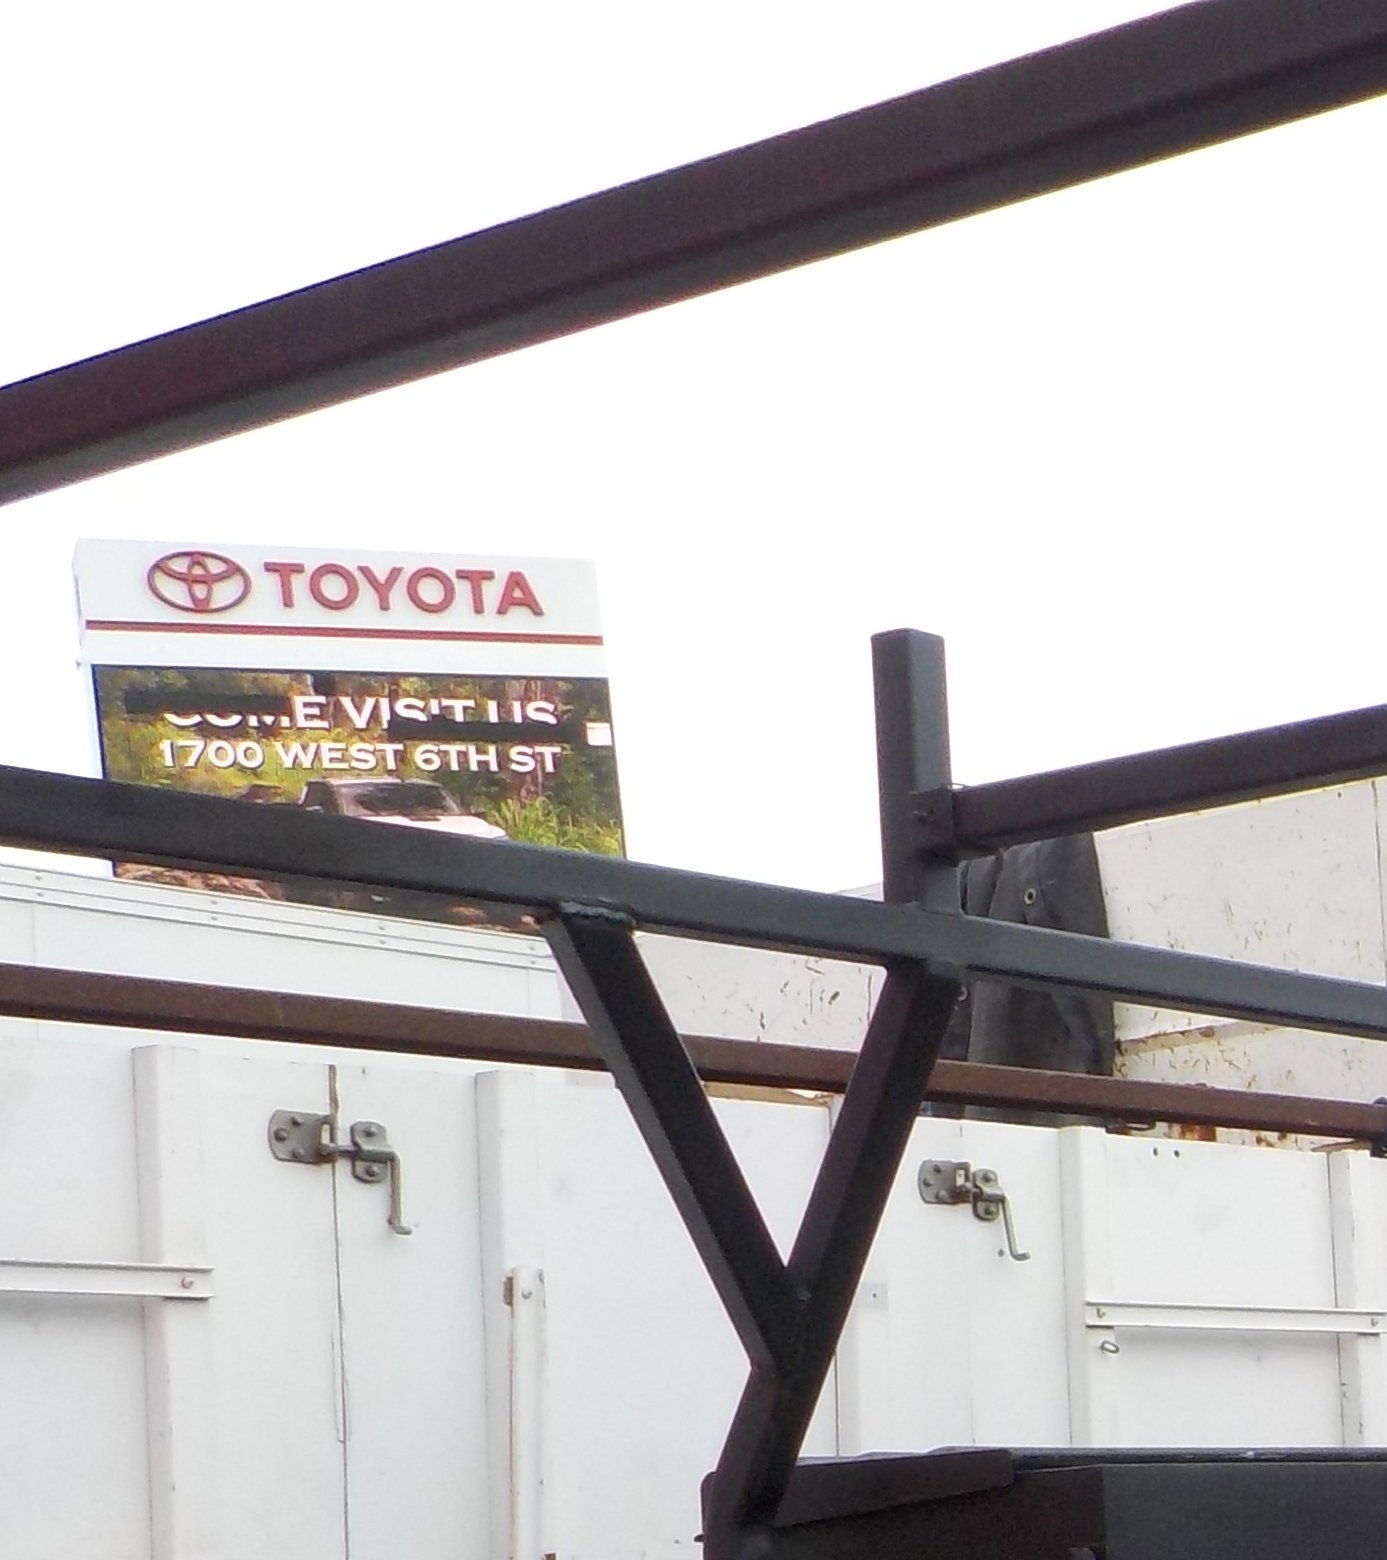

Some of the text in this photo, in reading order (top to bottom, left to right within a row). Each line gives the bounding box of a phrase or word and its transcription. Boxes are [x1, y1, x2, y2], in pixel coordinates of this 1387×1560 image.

[263, 562, 546, 616] TOYOTA
[160, 739, 562, 774] 1700 WEST 6TH ST
